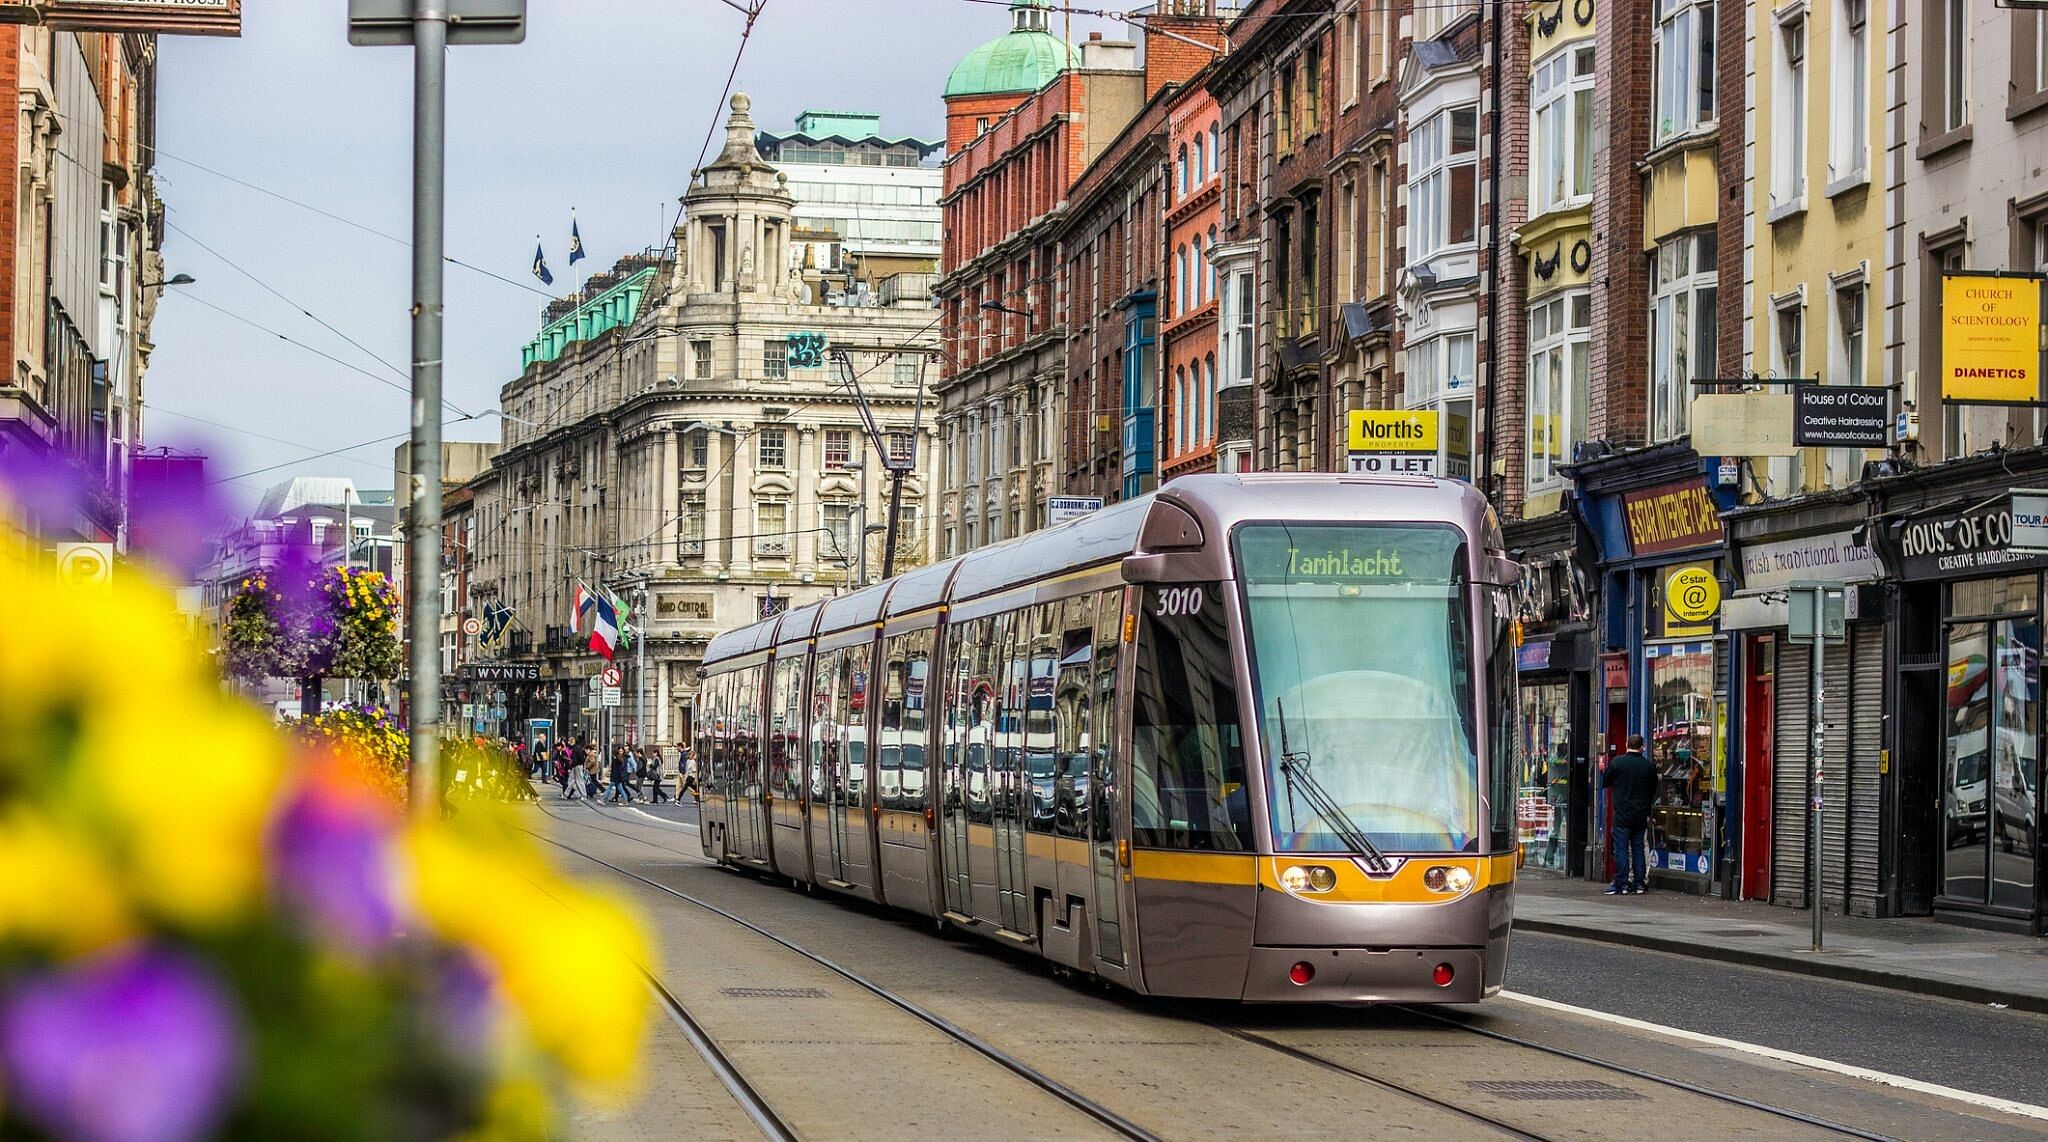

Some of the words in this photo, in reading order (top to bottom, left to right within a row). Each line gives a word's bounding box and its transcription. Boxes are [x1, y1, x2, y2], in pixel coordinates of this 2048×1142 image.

[1966, 289, 2013, 299] CHURCH
[1982, 303, 1997, 312] OF
[1951, 315, 2029, 326] SCIENTOLOGY
[1954, 368, 2026, 379] DIANETICS
[1803, 392, 1834, 405] House
[1837, 393, 1847, 405] of
[1850, 393, 1884, 406] Colour
[1804, 416, 1837, 425] Creative
[1838, 417, 1884, 429] Hairdressing
[1362, 420, 1424, 439] Norths
[1805, 430, 1883, 441] www.houseofcolour.ie
[1351, 458, 1382, 472] TO
[1391, 458, 1433, 472] LET
[1628, 498, 1659, 545] ESTAR
[1653, 489, 1695, 543] INTERNET
[2014, 514, 2041, 525] TOUR
[1902, 521, 1955, 557] HOUS
[1959, 516, 1982, 549] OF
[1985, 511, 2012, 546] CO
[1288, 548, 1403, 576] Tamhlacht
[1744, 551, 1770, 575] irish
[1774, 540, 1840, 571] traditional
[1938, 553, 1975, 571] CREATIVE
[1680, 574, 1708, 585] estar
[1156, 587, 1203, 616] 3010
[478, 668, 538, 679] WYNNS
